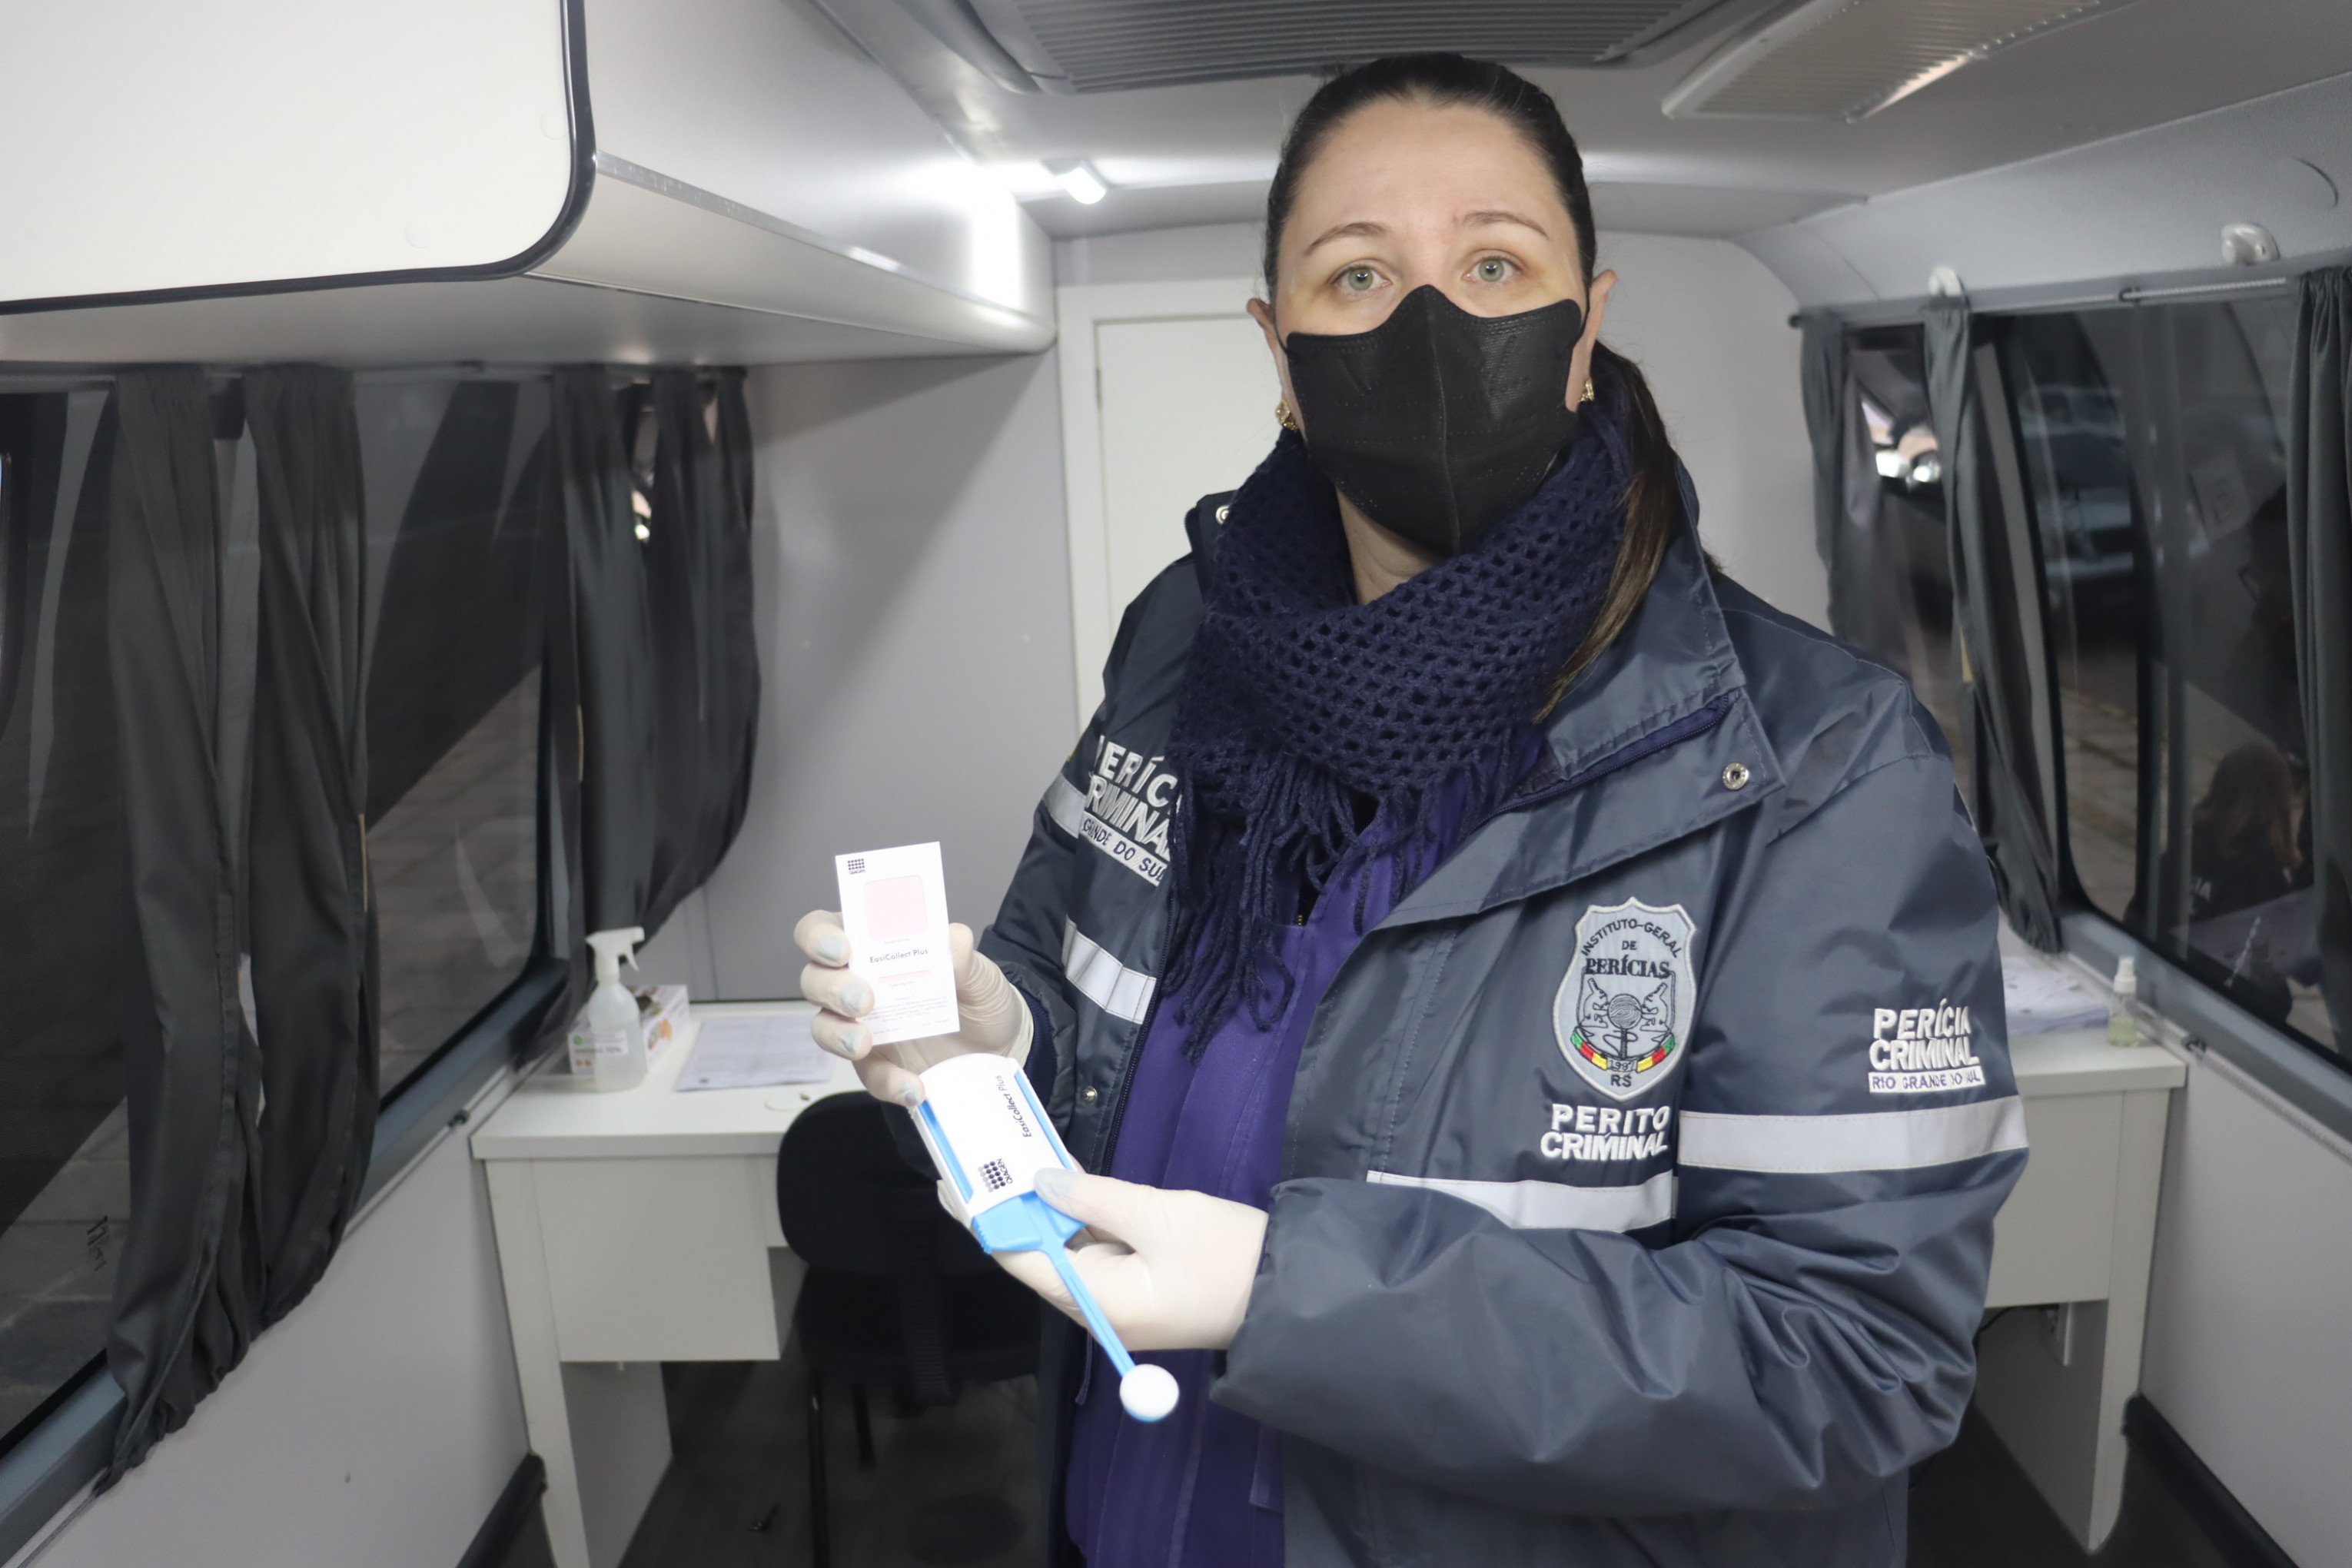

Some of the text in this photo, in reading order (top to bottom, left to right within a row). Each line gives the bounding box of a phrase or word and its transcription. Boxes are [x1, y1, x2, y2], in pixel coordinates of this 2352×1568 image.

[1095, 735, 1182, 814] ERÍC
[1113, 841, 1136, 861] DO
[869, 948, 929, 964] EasiCollect Plus
[1621, 940, 1637, 951] DE
[1585, 954, 1672, 979] PERÍCIAS
[1873, 998, 1972, 1040] PERÍCIA
[1869, 1035, 1981, 1071] CRIMINAL
[1610, 1074, 1633, 1088] RS
[1872, 1075, 1897, 1090] RIO
[995, 1075, 1032, 1138] EasiCollect Plus
[1551, 1103, 1671, 1134] PERITO
[1540, 1131, 1669, 1161] CRIMINAL
